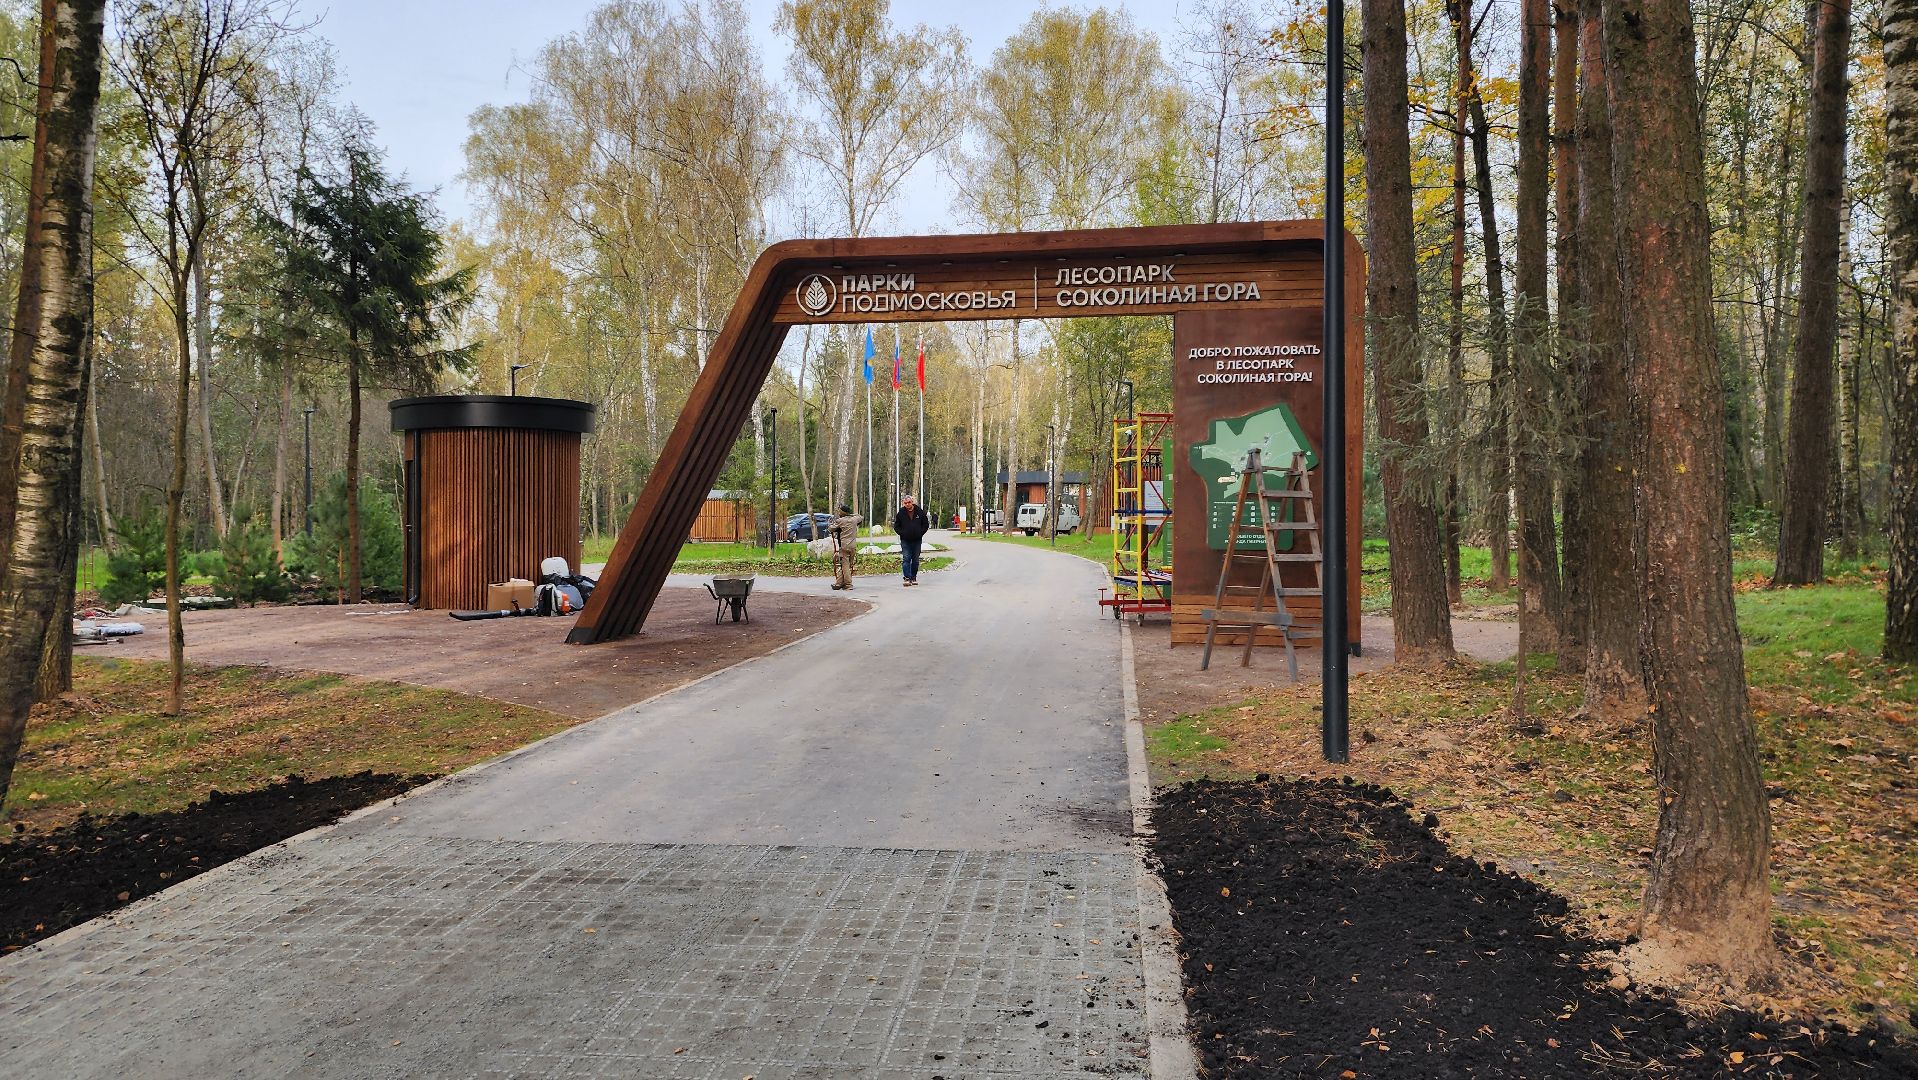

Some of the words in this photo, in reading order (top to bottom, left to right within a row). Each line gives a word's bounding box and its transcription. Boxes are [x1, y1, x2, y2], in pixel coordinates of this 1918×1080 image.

[842, 273, 916, 293] ПАРКИ
[1055, 264, 1176, 286] ЛЕСОПАРК
[842, 290, 1017, 313] ПОДМОСКОВЬЯ
[1056, 284, 1197, 308] СОКОЛИНАЯ
[1203, 282, 1261, 302] ГОРА
[1189, 346, 1232, 359] ДОБРО
[1234, 344, 1321, 357] ПОЖАЛОВАТЬ
[1216, 360, 1225, 370] В
[1226, 359, 1294, 370] ЛЕСОПАРК
[1197, 372, 1275, 384] СОКОЛИНАЯ
[1277, 371, 1313, 382] ГОРА!
